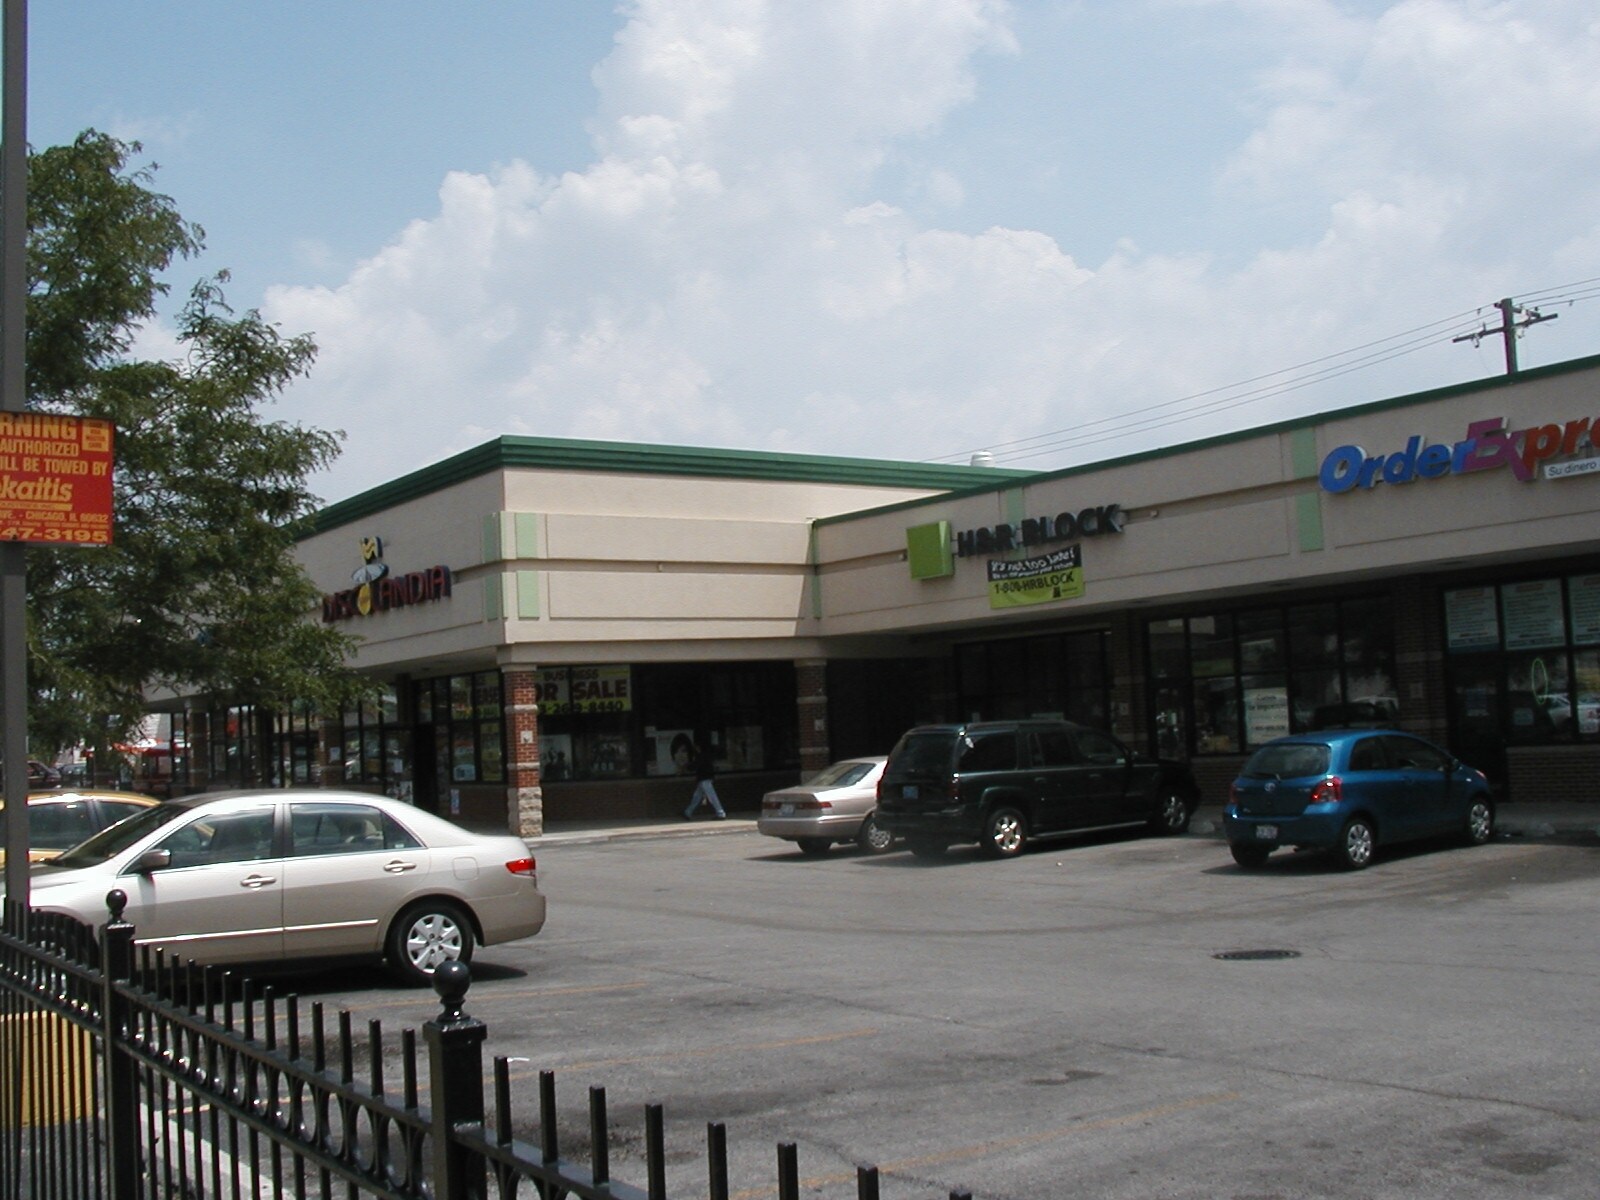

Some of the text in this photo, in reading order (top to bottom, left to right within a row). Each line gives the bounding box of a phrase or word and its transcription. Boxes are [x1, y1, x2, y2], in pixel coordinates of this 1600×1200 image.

[0, 413, 77, 440] RNING
[0, 439, 78, 456] AUTHORIZED
[24, 457, 39, 472] BE
[44, 458, 88, 475] TOWED
[92, 462, 108, 476] BY
[1548, 460, 1597, 476] Su dinero
[0, 475, 73, 501] kaitis
[1, 527, 108, 541] 47-3195
[957, 503, 1122, 558] H&R BLOCK
[1007, 560, 1026, 572] not
[1025, 559, 1047, 570] too
[994, 571, 1074, 594] 1-800-HRBLOCK
[573, 679, 627, 700] SALE
